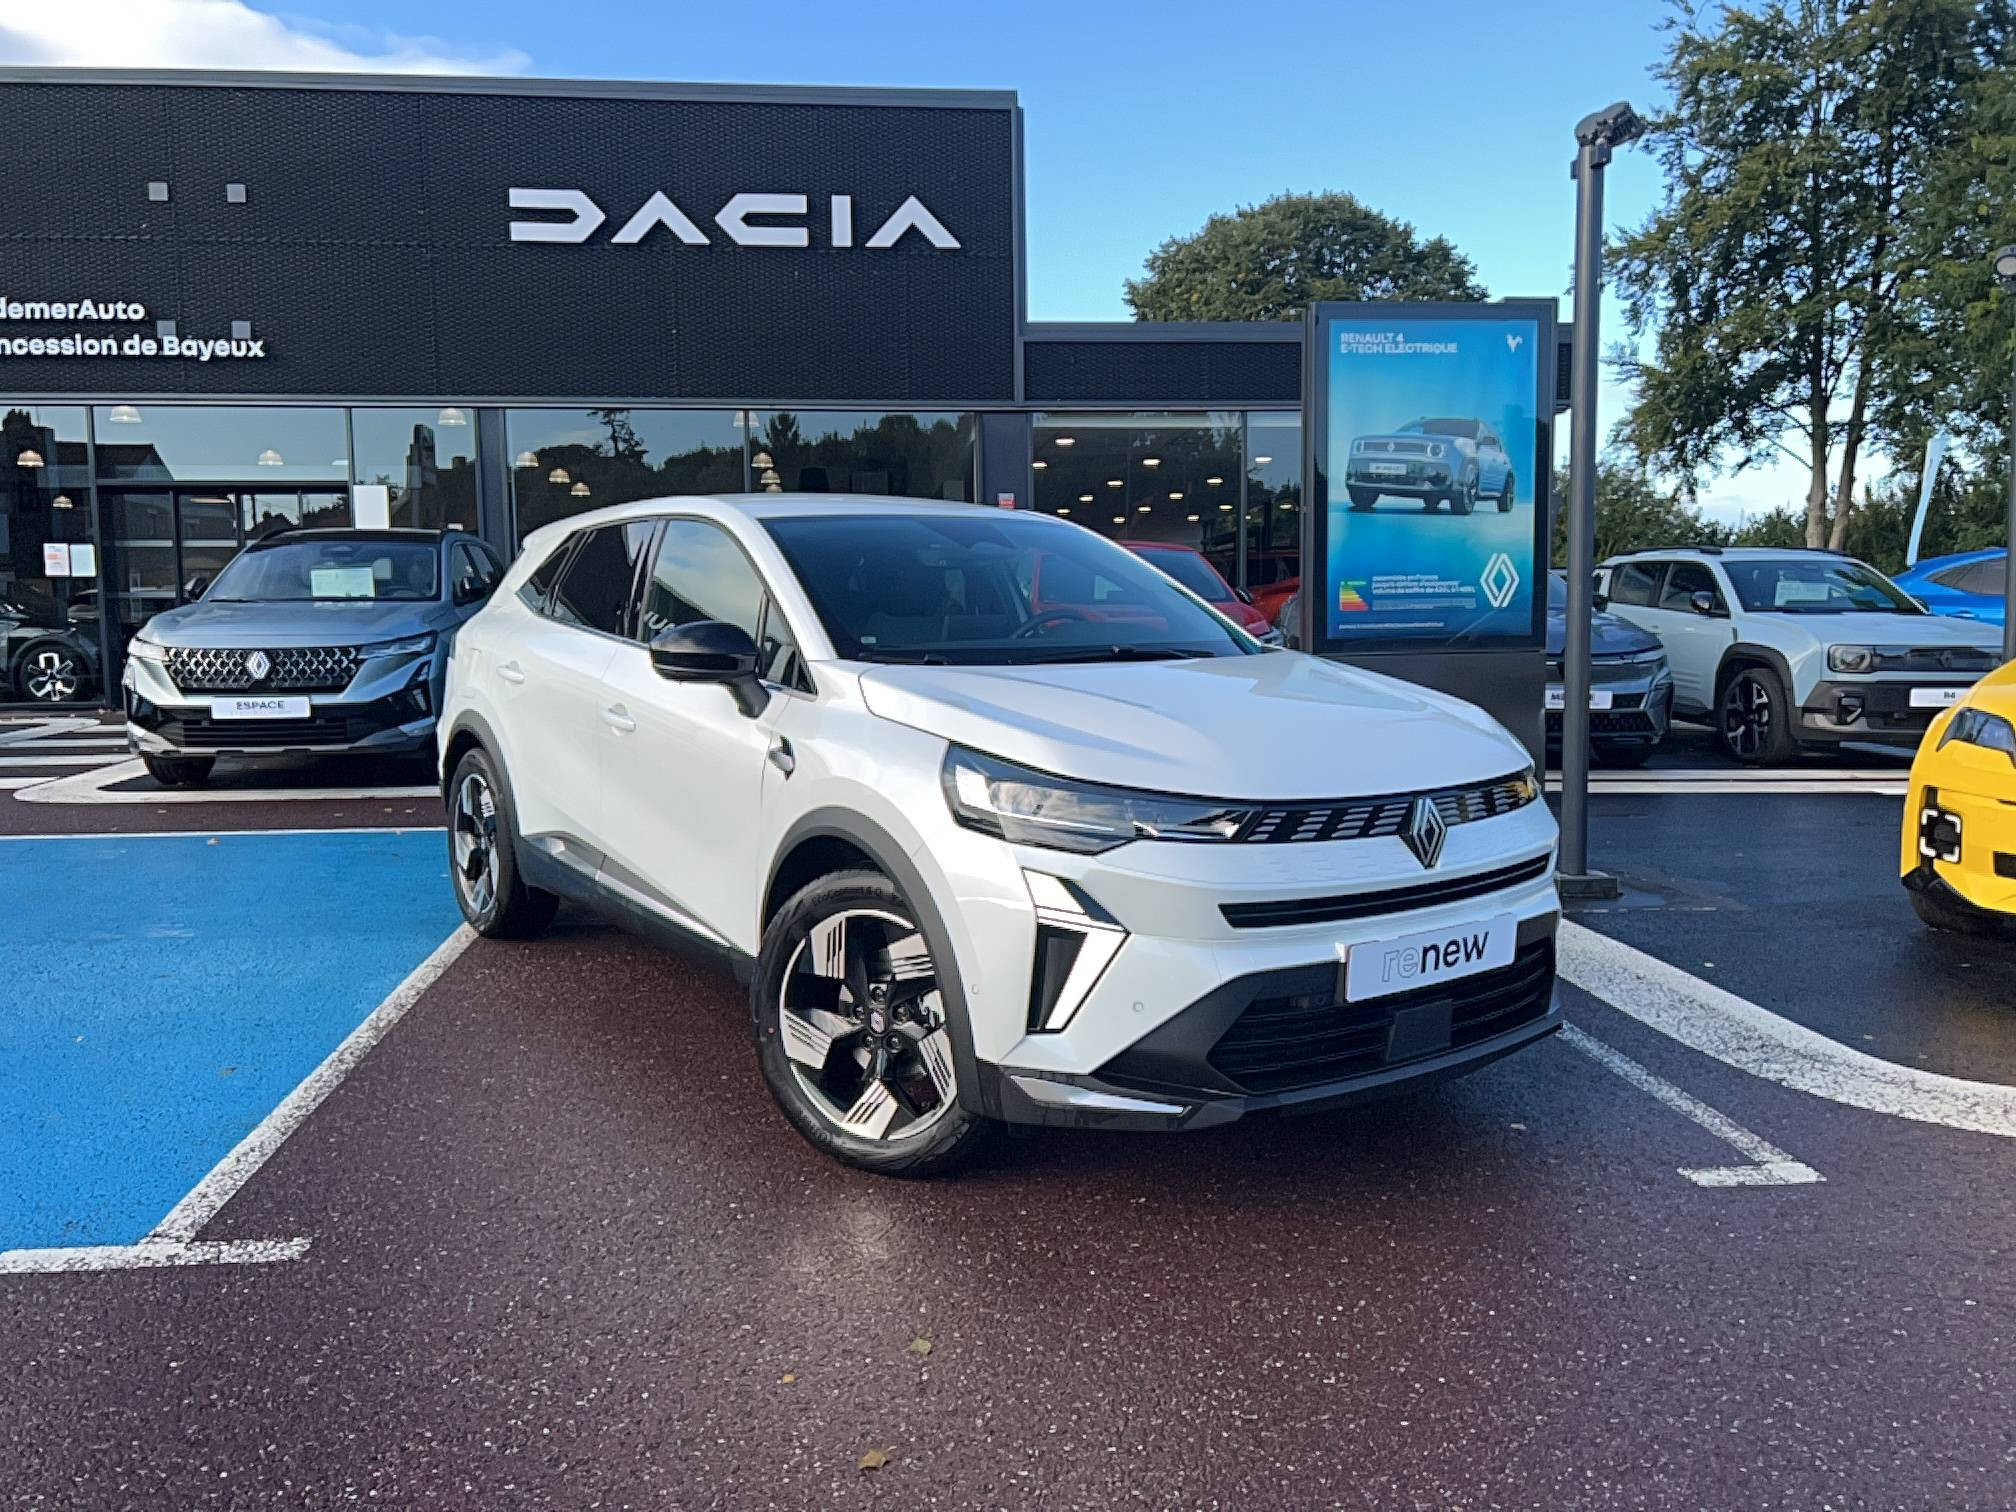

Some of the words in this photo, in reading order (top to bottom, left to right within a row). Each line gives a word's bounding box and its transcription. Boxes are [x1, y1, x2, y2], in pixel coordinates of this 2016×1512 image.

[508, 187, 962, 250] DACIA
[0, 333, 118, 356] ncession
[123, 333, 158, 356] de
[162, 335, 266, 362] Bayeux
[1340, 332, 1393, 343] RENAULT
[1395, 332, 1404, 343] 4
[1340, 343, 1382, 354] E-TECH
[236, 700, 285, 710] ESPACE
[1381, 931, 1490, 983] renew
